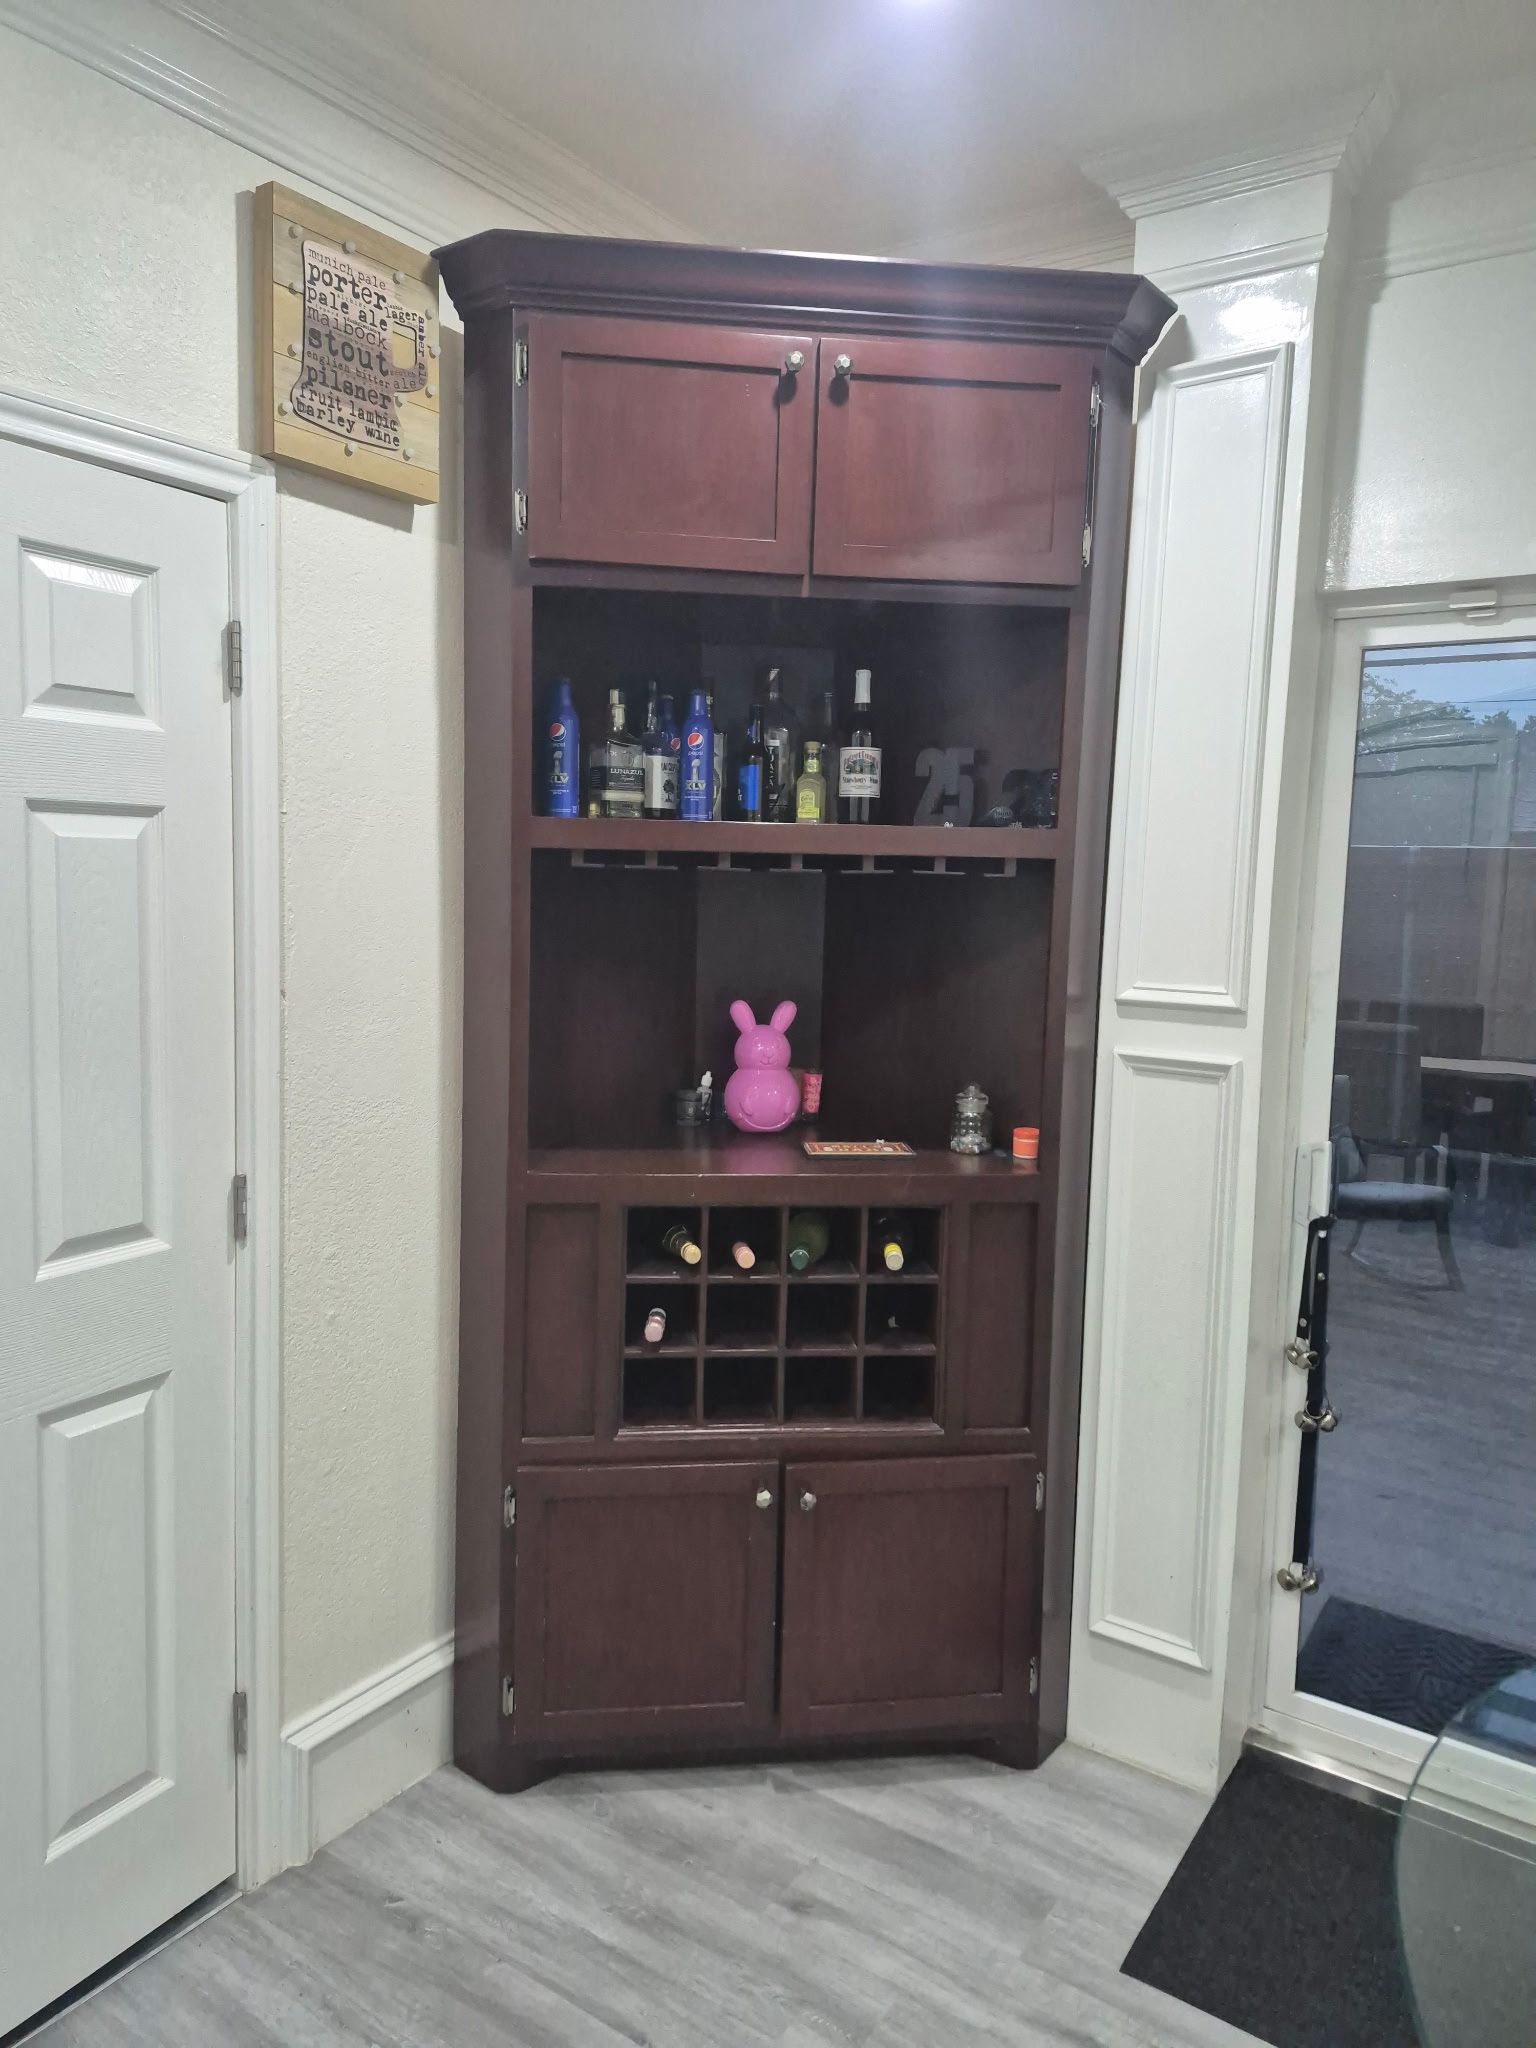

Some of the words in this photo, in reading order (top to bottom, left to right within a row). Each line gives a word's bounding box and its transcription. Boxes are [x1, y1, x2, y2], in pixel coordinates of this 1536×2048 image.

[306, 262, 387, 311] porter
[308, 248, 353, 277] munich
[357, 271, 386, 291] pale
[306, 286, 349, 315] pale
[358, 309, 388, 332] ale
[306, 305, 388, 350] maibock
[384, 306, 418, 324] lager
[308, 327, 389, 378] stout
[418, 315, 426, 358] amber
[305, 364, 391, 410] pilsner
[306, 350, 350, 374] english
[355, 367, 390, 389] bitter
[394, 377, 417, 389] ale
[295, 397, 355, 434] barley
[364, 425, 400, 447] wine
[300, 381, 343, 413] fruit
[349, 400, 399, 432] lambic
[610, 767, 644, 776] LUNAZUL
[914, 747, 975, 827] 25
